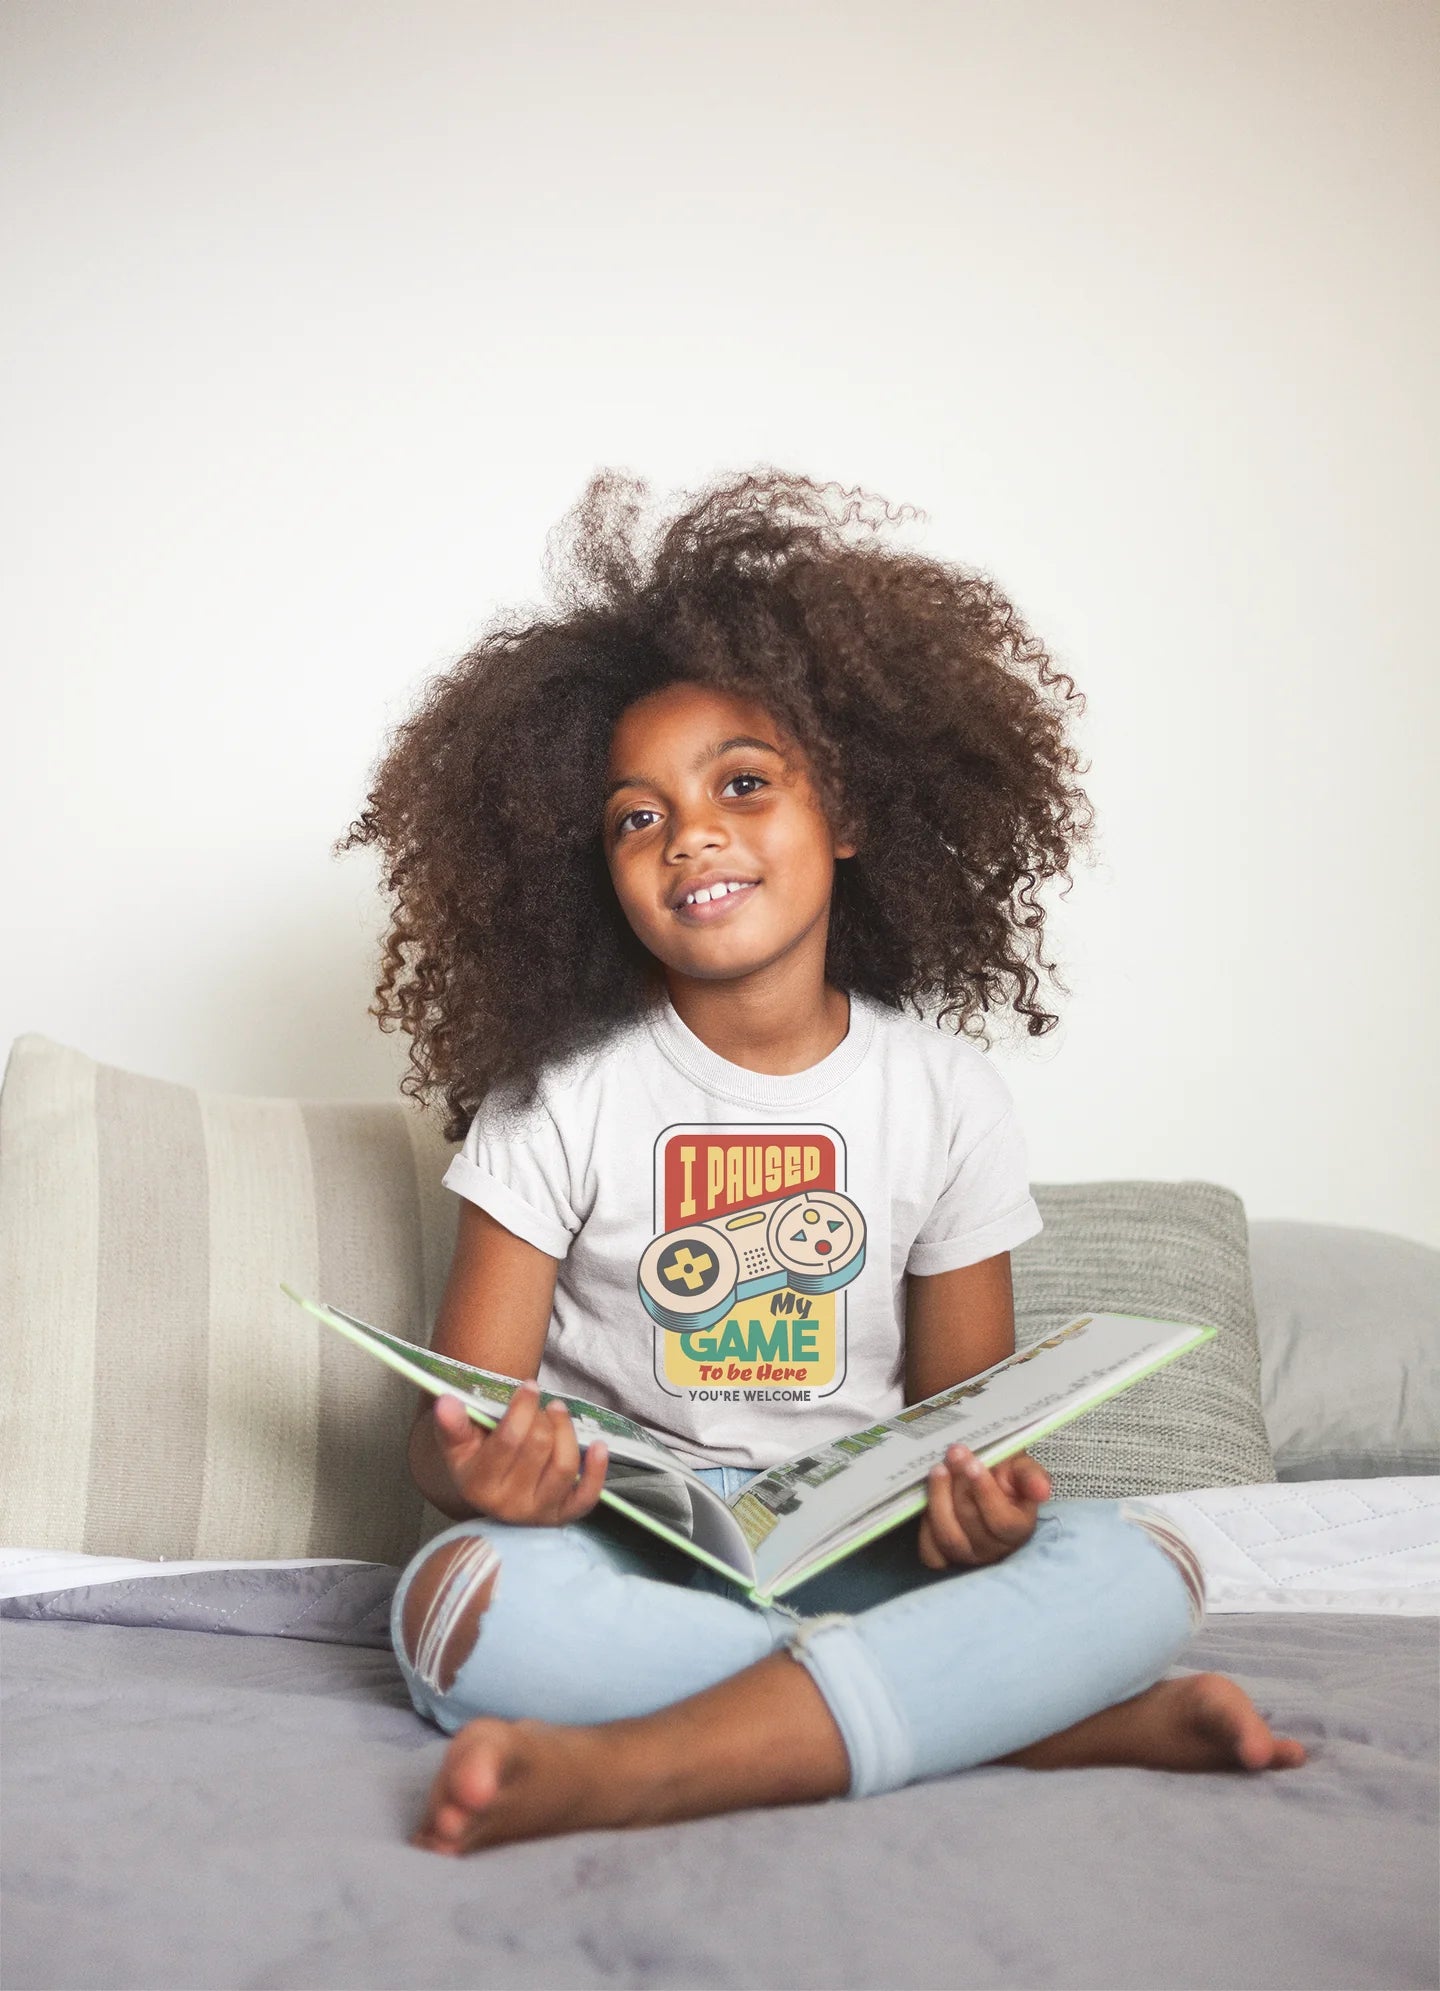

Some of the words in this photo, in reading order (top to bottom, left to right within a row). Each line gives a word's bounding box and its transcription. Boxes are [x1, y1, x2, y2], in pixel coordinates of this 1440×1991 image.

[680, 1146, 696, 1218] I
[707, 1145, 821, 1210] PAUSED
[770, 1292, 812, 1319] My
[680, 1319, 819, 1362] GAME
[699, 1364, 723, 1381] To
[727, 1363, 752, 1381] be
[756, 1363, 807, 1381] Here
[689, 1390, 740, 1402] YOU'RE
[743, 1390, 811, 1402] WELCOME
